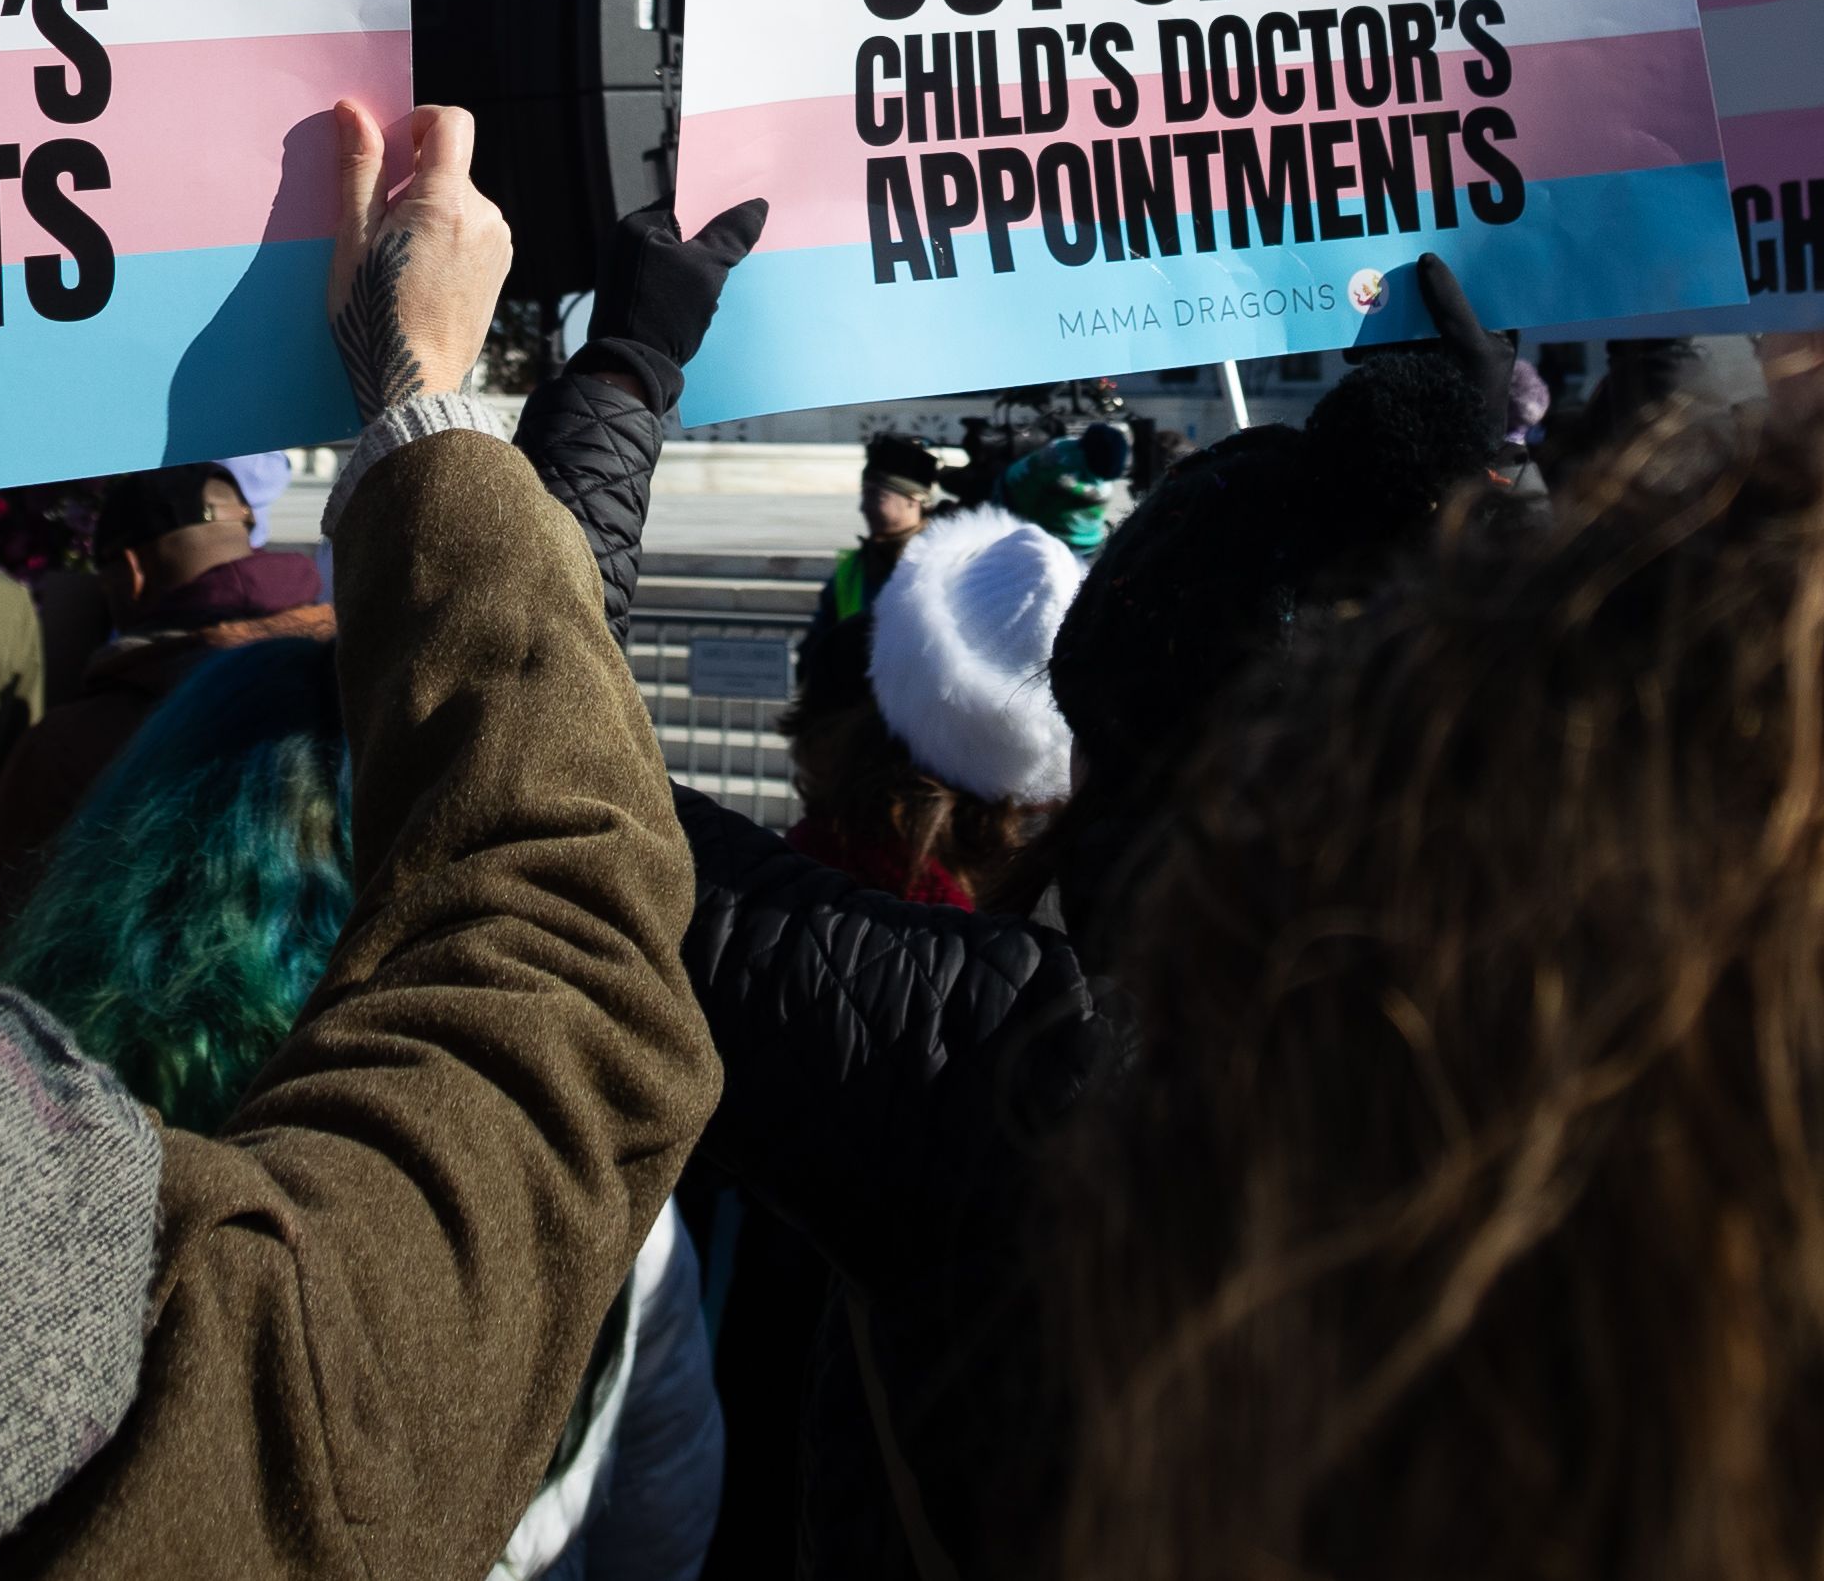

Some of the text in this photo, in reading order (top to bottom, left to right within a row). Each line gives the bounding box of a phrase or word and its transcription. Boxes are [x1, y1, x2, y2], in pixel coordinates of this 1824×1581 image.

[854, 22, 1139, 148] CHILD'S
[864, 106, 1527, 284] APPOINTMENTS
[1058, 283, 1336, 340] MAMA DRAGONS
